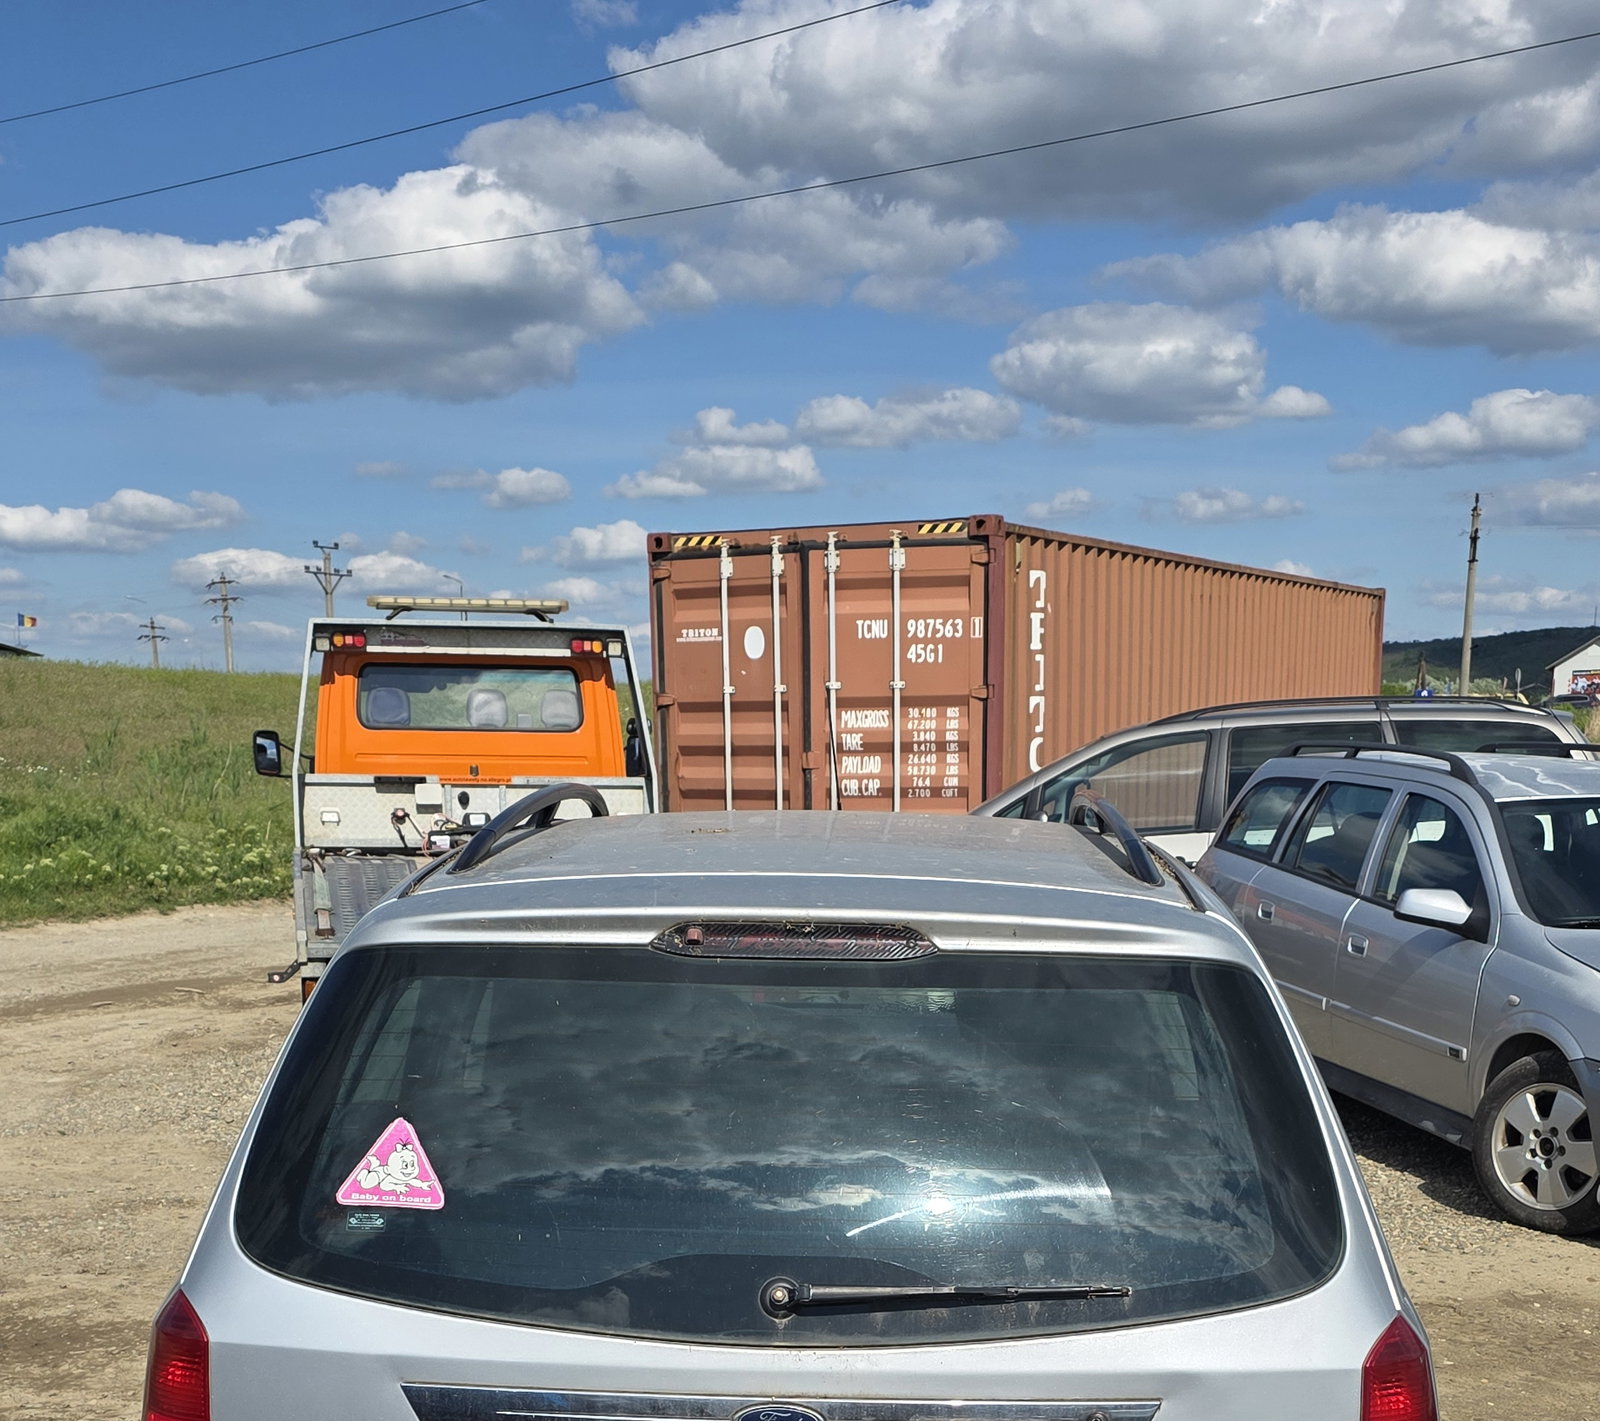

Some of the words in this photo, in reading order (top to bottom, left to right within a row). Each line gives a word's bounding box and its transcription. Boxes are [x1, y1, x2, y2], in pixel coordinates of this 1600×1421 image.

[681, 628, 719, 637] TRITON
[856, 619, 888, 639] TCNU
[907, 618, 963, 638] 987563
[907, 643, 943, 663] 45G1
[946, 707, 960, 717] KGS
[907, 719, 937, 729] 67.200
[946, 719, 959, 729] LBS
[841, 733, 864, 751] TARE
[912, 731, 936, 741] 3.840
[945, 731, 959, 741] KGS
[913, 743, 936, 752] 8.470
[946, 743, 959, 752] LBS
[841, 755, 882, 774] PAYLOAD
[908, 754, 937, 764] 26.640
[946, 753, 960, 763] KGS
[907, 765, 936, 775] 58.730
[946, 765, 959, 775] LBS
[841, 779, 861, 796] CUB.
[862, 779, 882, 797] CAP.
[912, 777, 930, 787] 76.4
[908, 789, 931, 798] 2.700
[941, 789, 958, 797] CUFT
[351, 1192, 379, 1201] Baby
[399, 1195, 431, 1203] board
